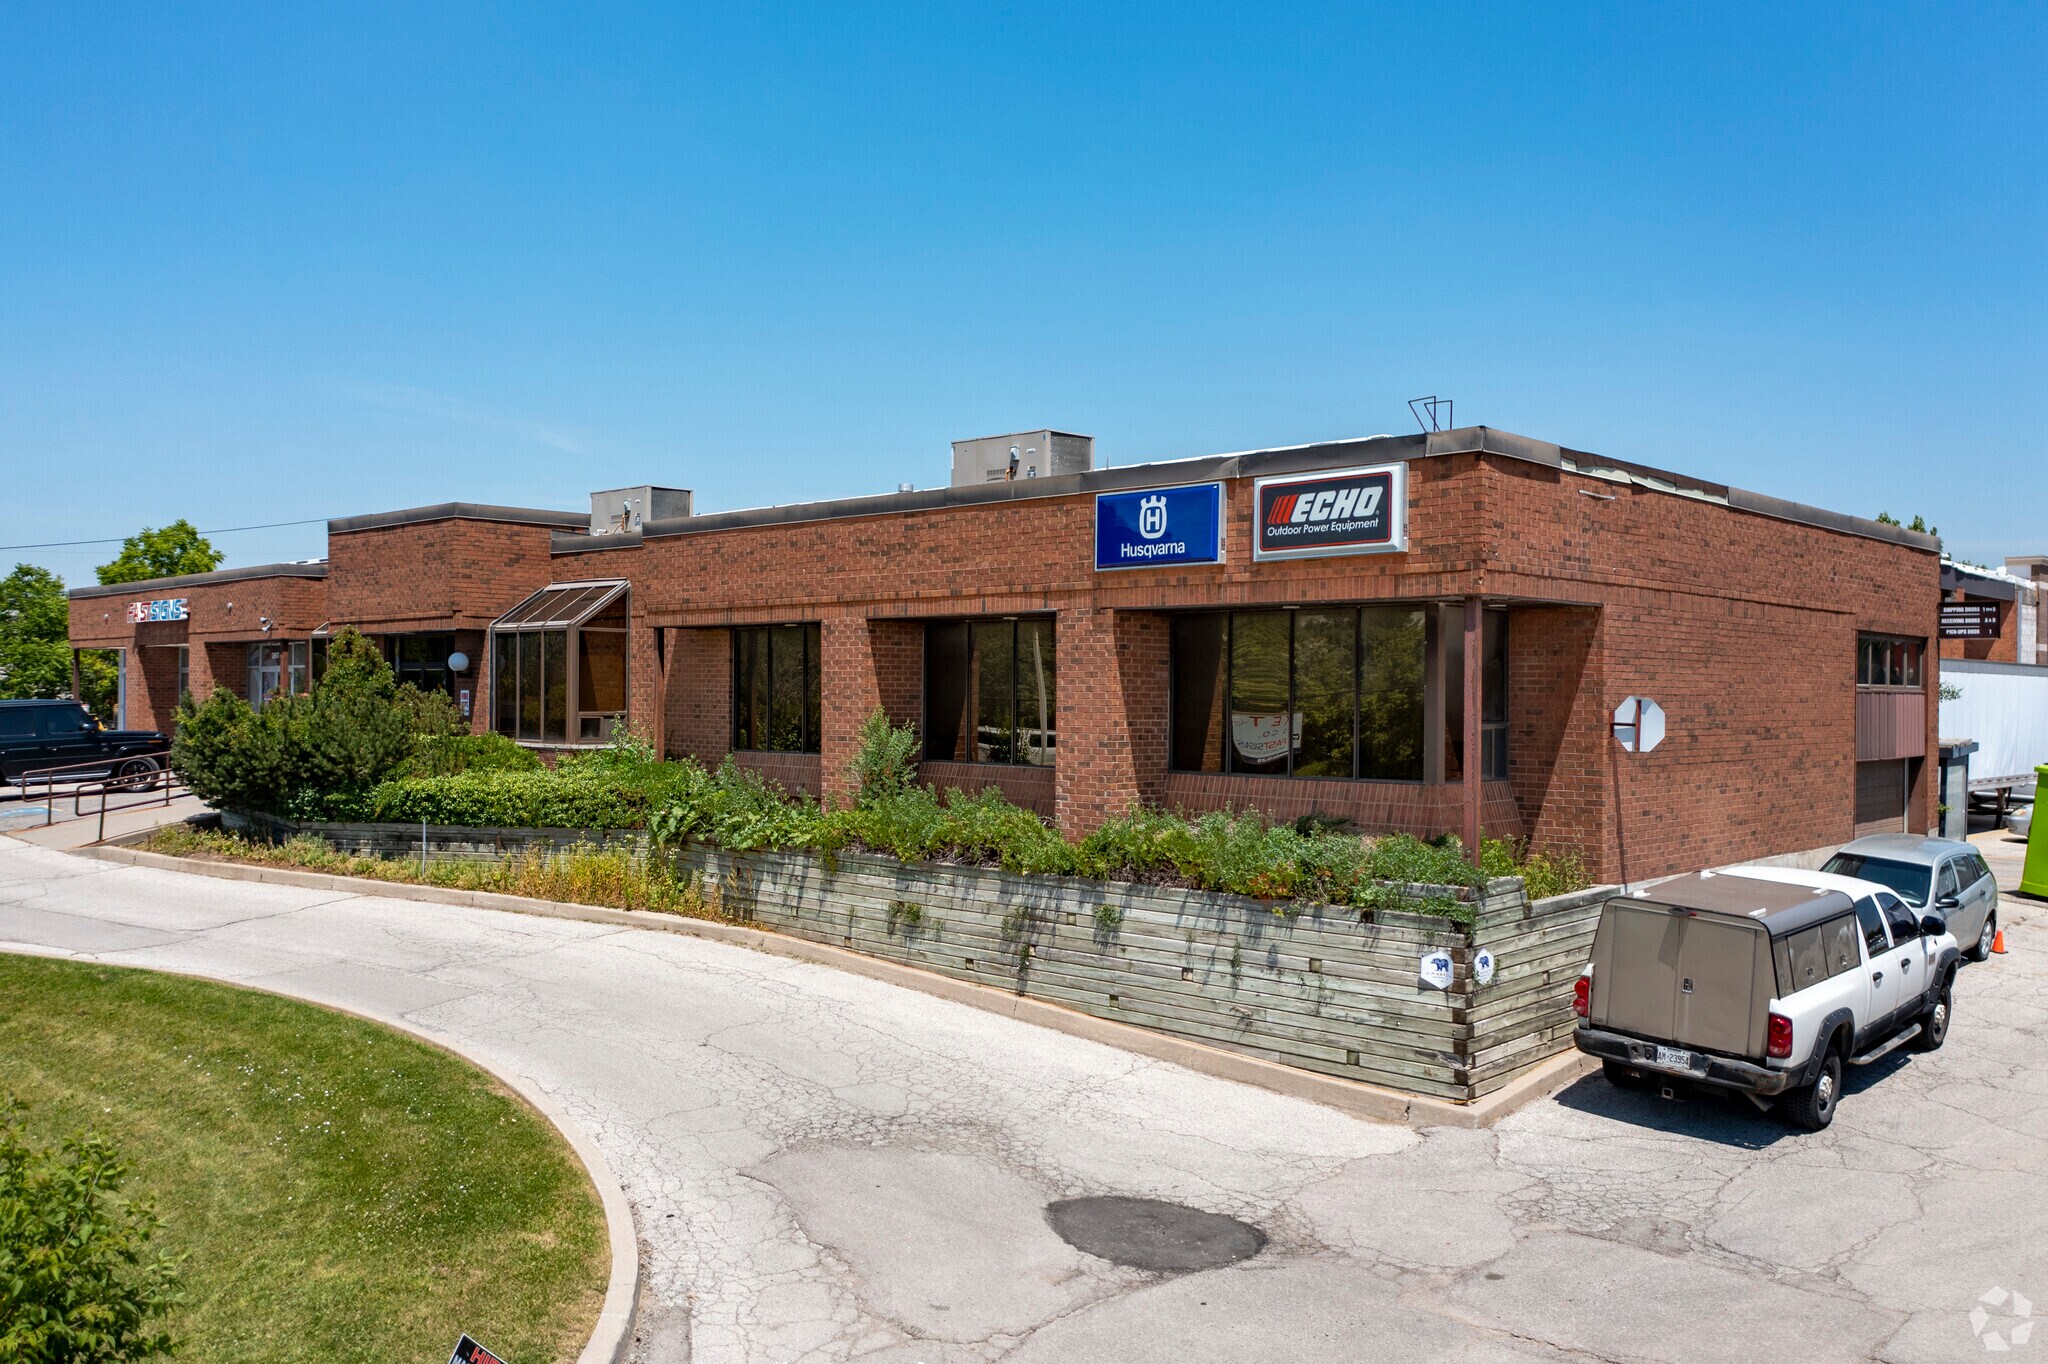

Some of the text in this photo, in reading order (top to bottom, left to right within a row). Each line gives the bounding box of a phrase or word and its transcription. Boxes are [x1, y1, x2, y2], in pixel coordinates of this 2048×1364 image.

[1290, 486, 1384, 523] ECHO
[1267, 517, 1379, 537] Outdoor Power Equipment
[1120, 541, 1186, 559] Husqvarna
[127, 599, 184, 623] FASTSIGNS
